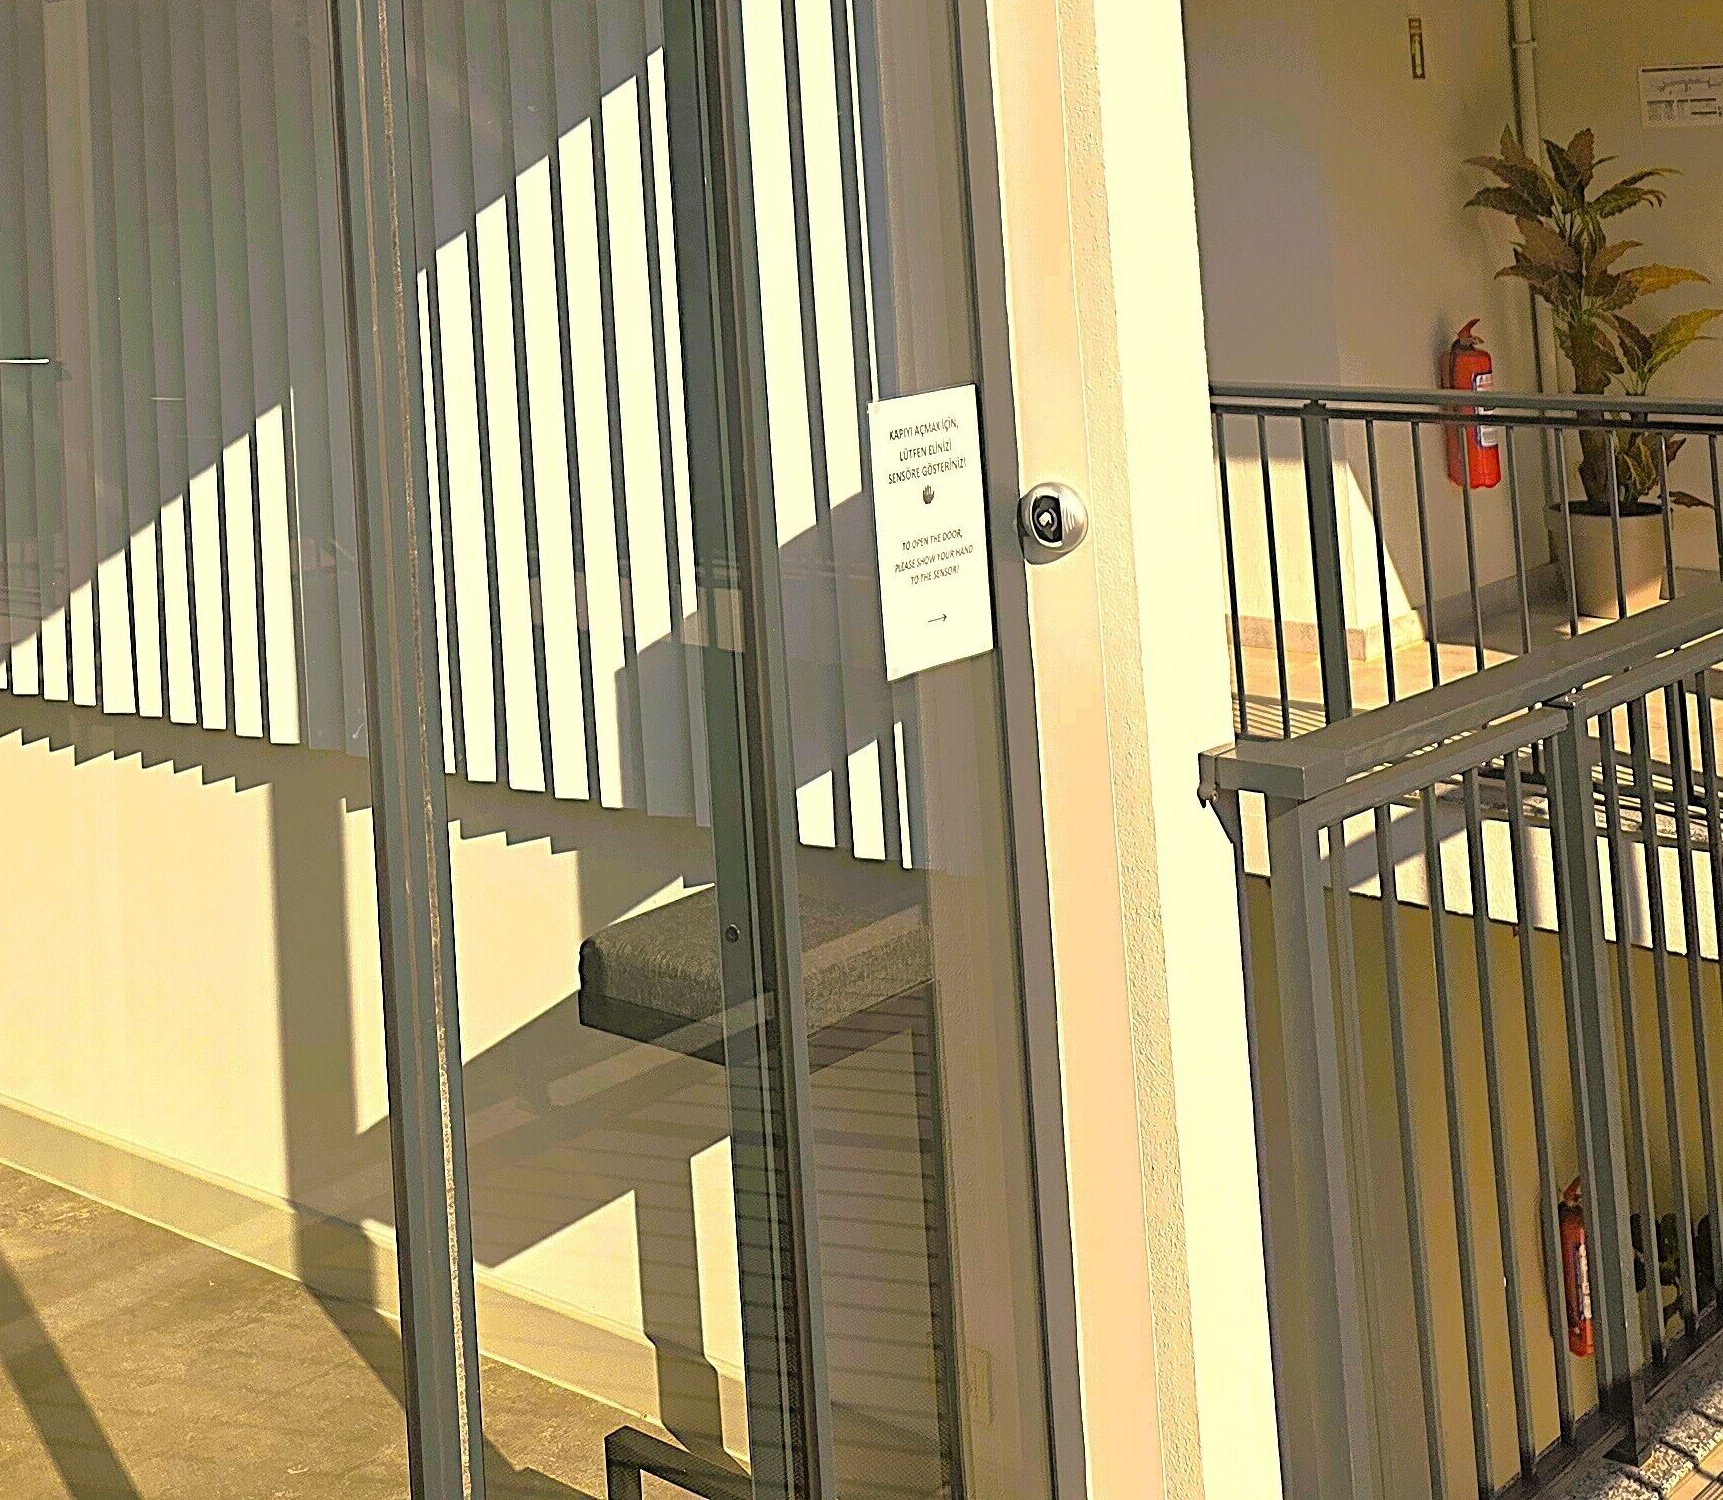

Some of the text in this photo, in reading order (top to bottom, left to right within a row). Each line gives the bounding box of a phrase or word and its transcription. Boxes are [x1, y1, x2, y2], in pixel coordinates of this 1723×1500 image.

[890, 427, 912, 440] KAPIYI
[915, 421, 940, 436] AÇMAK
[900, 439, 952, 461] LÜTFEN ELİNİZİ
[888, 468, 920, 484] SENSÖRE
[903, 542, 910, 550] TO
[912, 536, 929, 548] OPEN
[930, 534, 941, 544] THE
[895, 545, 973, 573] PLEASE SHOW YOUR HAND
[911, 576, 919, 585] TO
[921, 572, 931, 582] THE
